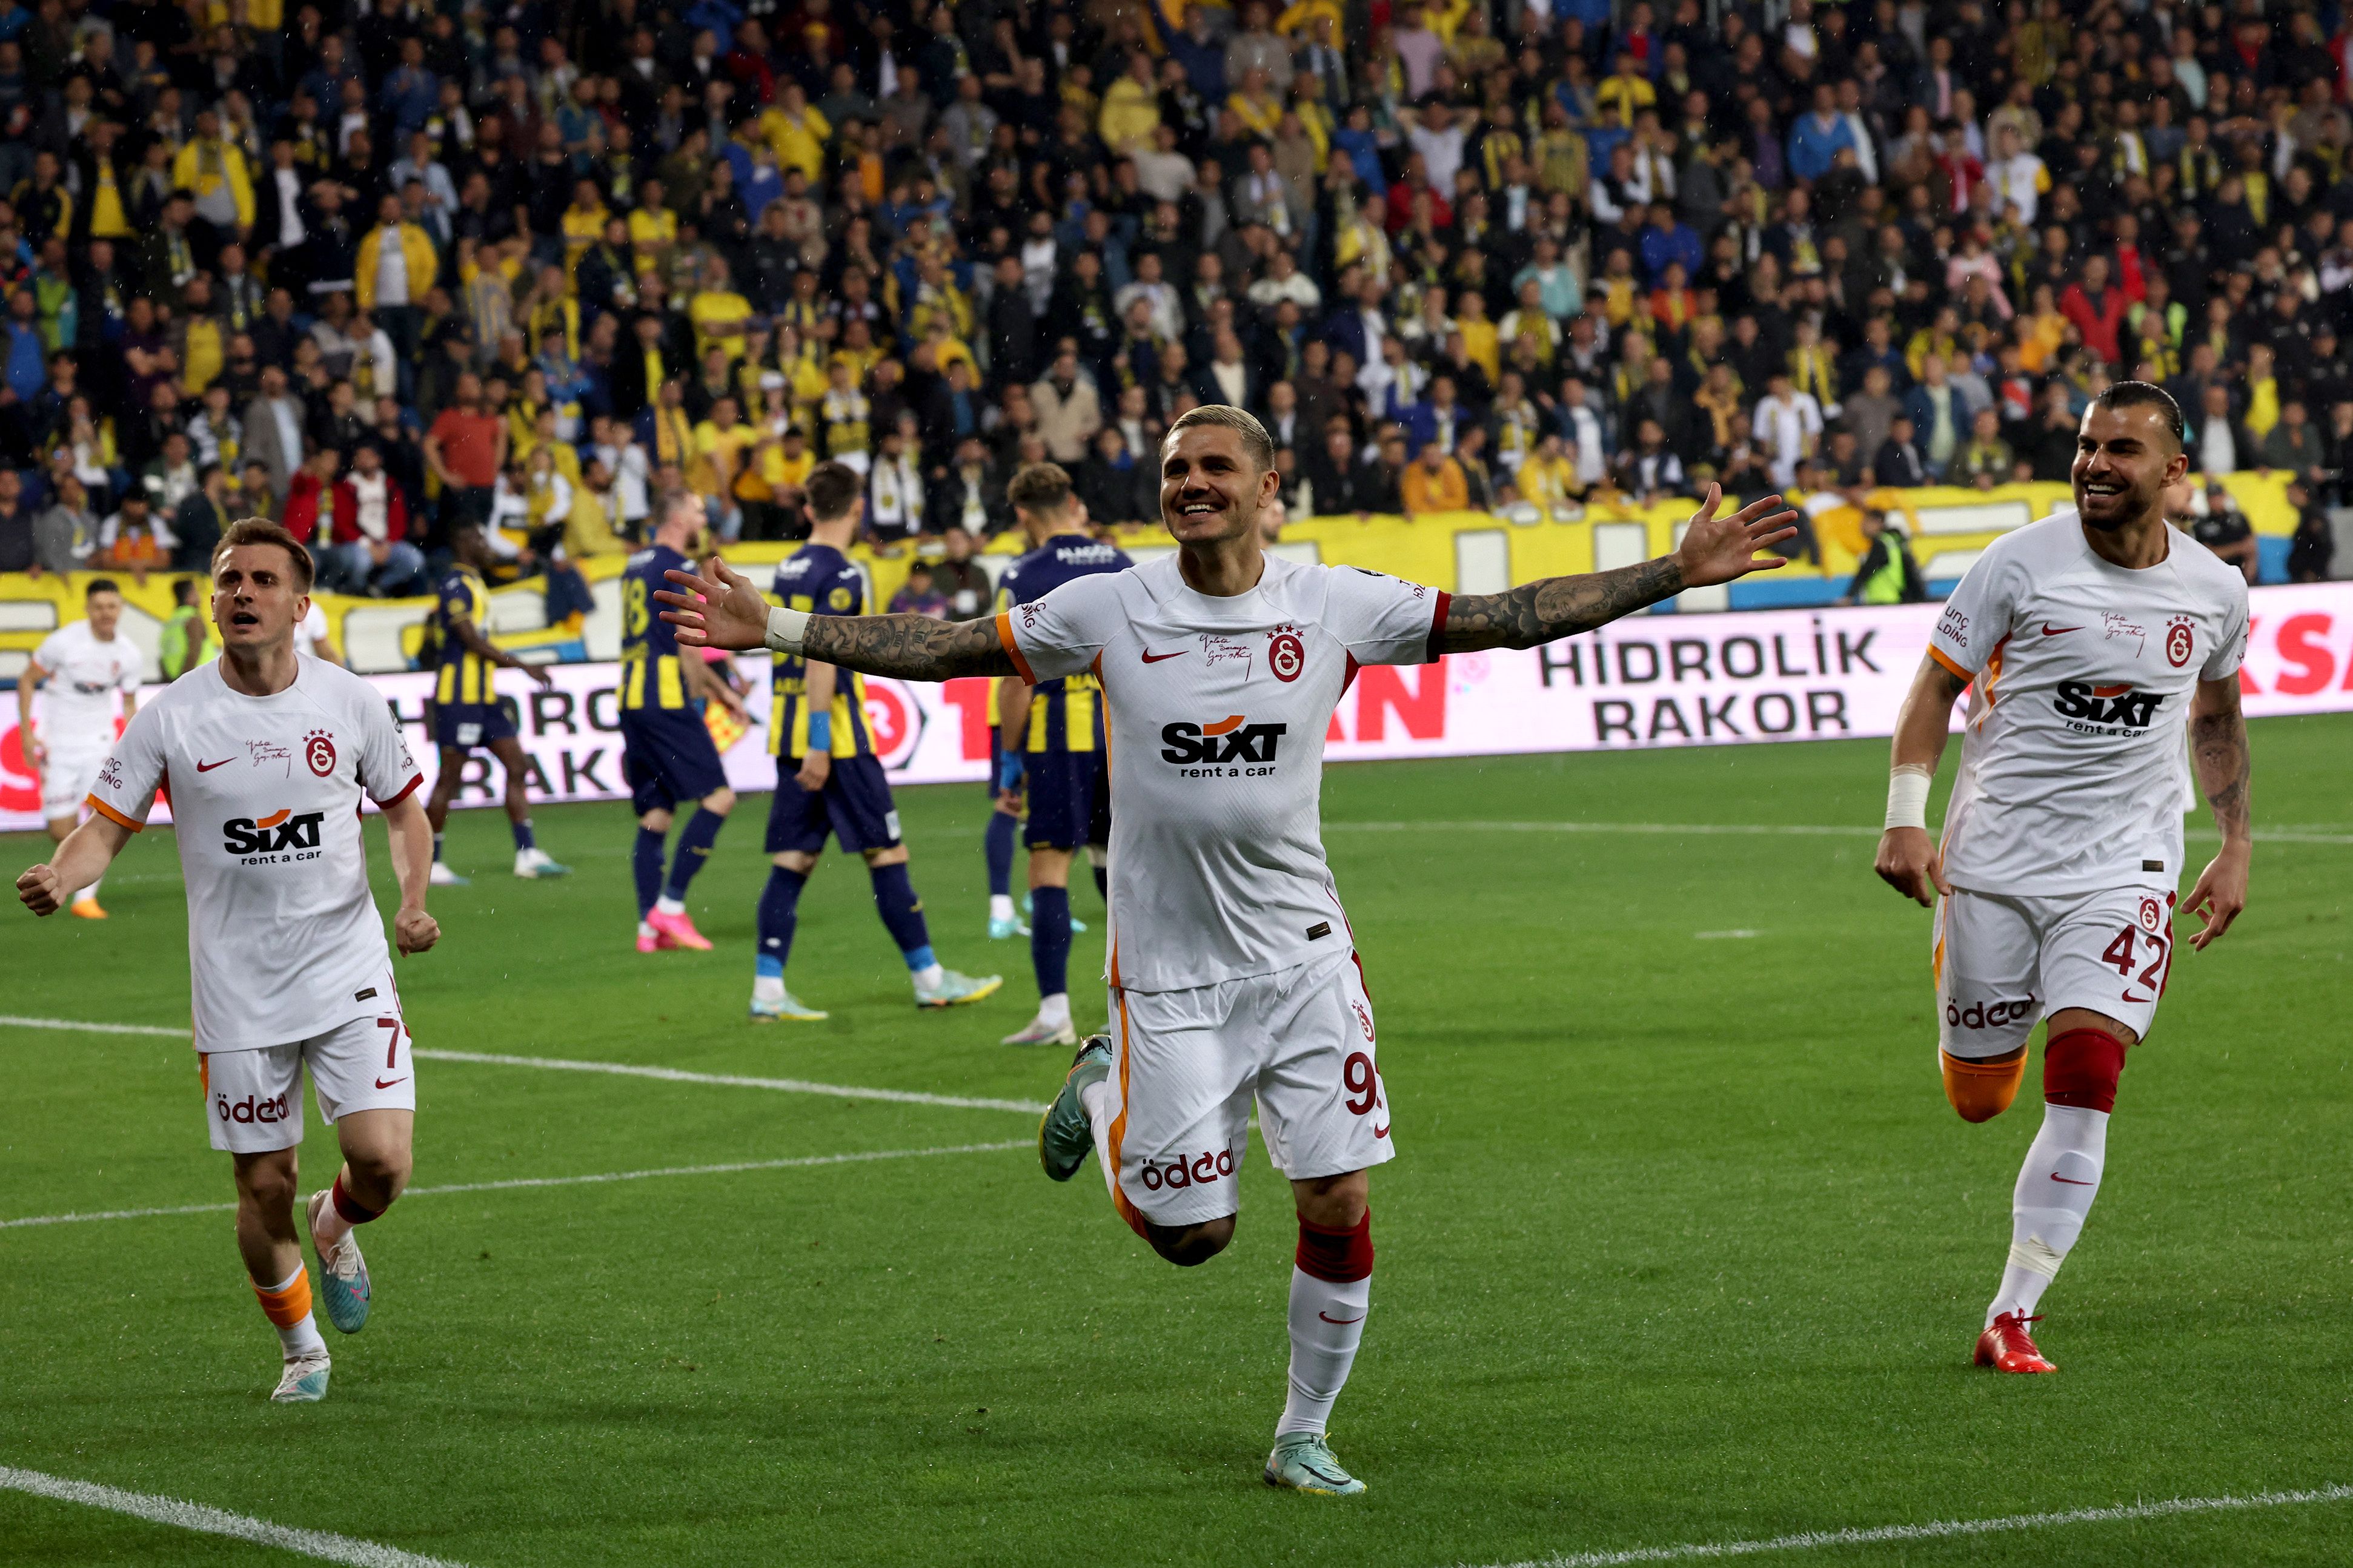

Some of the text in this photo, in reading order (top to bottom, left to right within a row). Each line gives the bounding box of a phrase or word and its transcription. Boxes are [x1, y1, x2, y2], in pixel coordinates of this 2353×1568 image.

[1539, 619, 1880, 688] HİDROLİK
[1937, 620, 1968, 647] LDİNG
[1593, 690, 1850, 741] RAKOR
[2065, 721, 2103, 734] rent
[1181, 766, 1276, 778] rent a car
[241, 855, 277, 865] rent
[296, 850, 322, 861] car
[2102, 924, 2165, 991] 42
[377, 1017, 400, 1069] 7
[1343, 1051, 1382, 1116] 9
